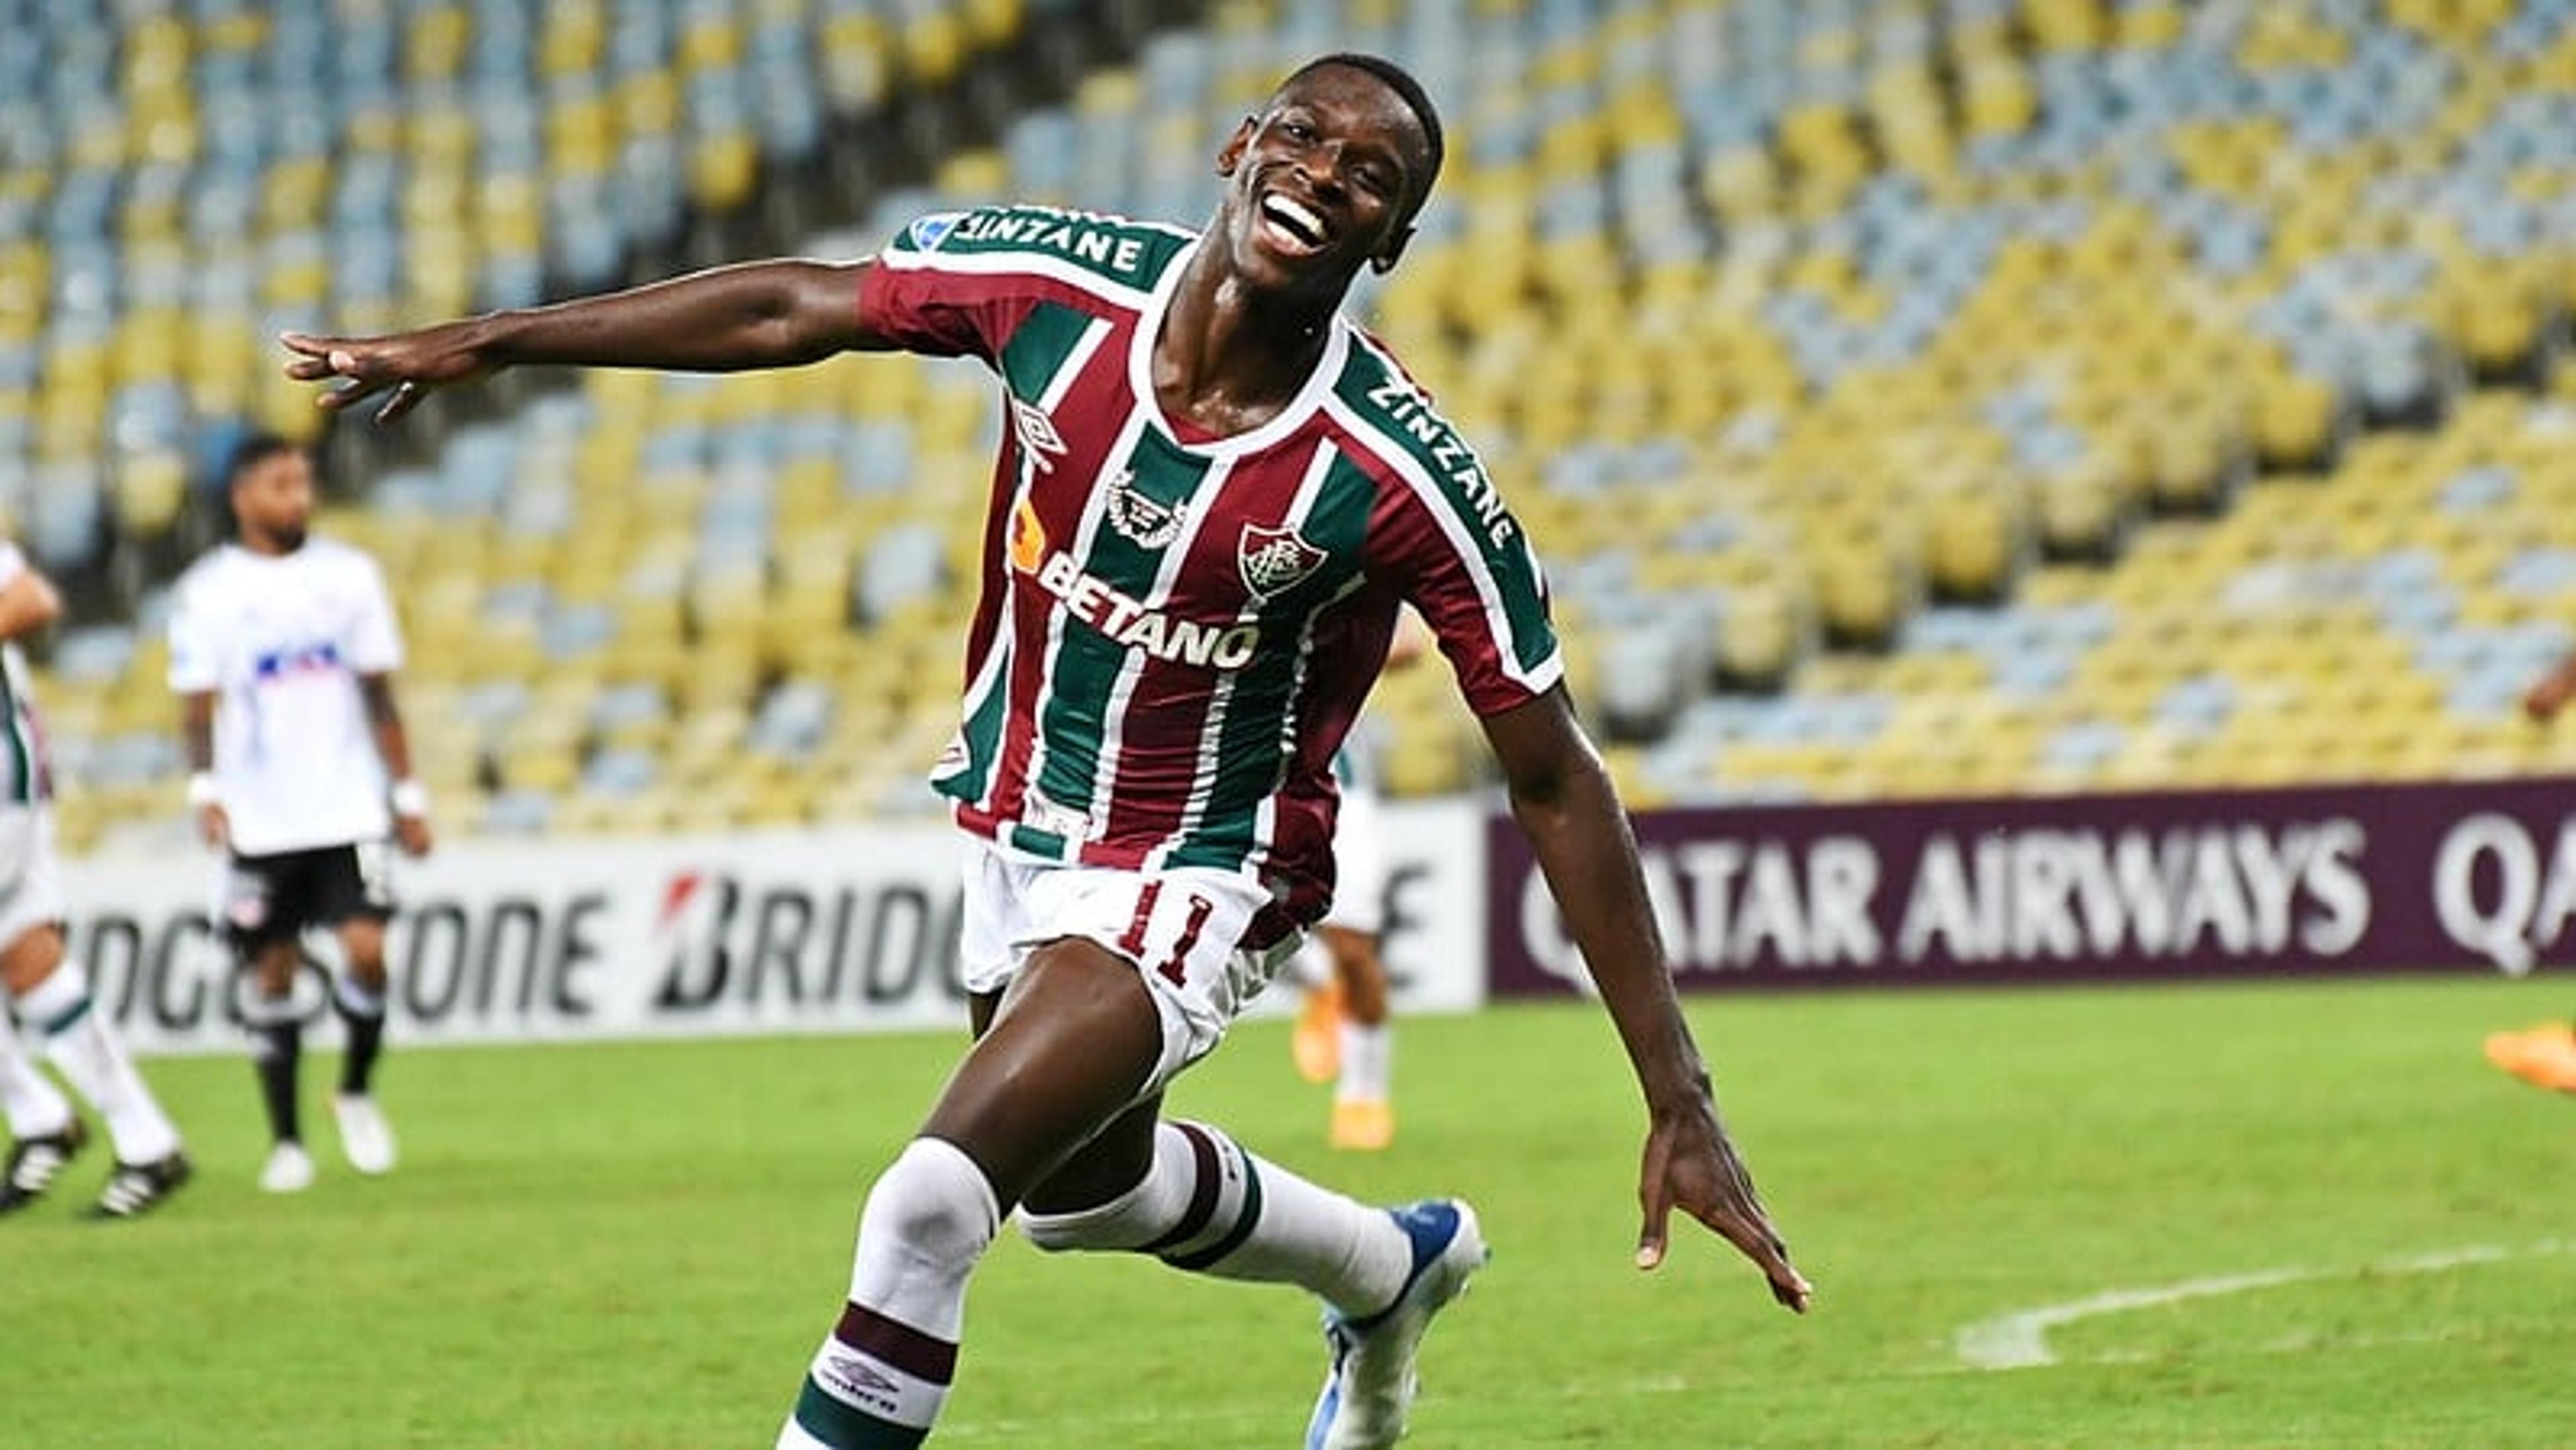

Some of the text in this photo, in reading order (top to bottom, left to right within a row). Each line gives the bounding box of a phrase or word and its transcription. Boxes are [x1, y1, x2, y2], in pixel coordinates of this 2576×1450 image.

[1366, 376, 1514, 550] ZINZANE
[1038, 550, 1261, 669] BETANO
[1118, 879, 1214, 990] 11
[1898, 818, 2371, 963] AIRWAYS
